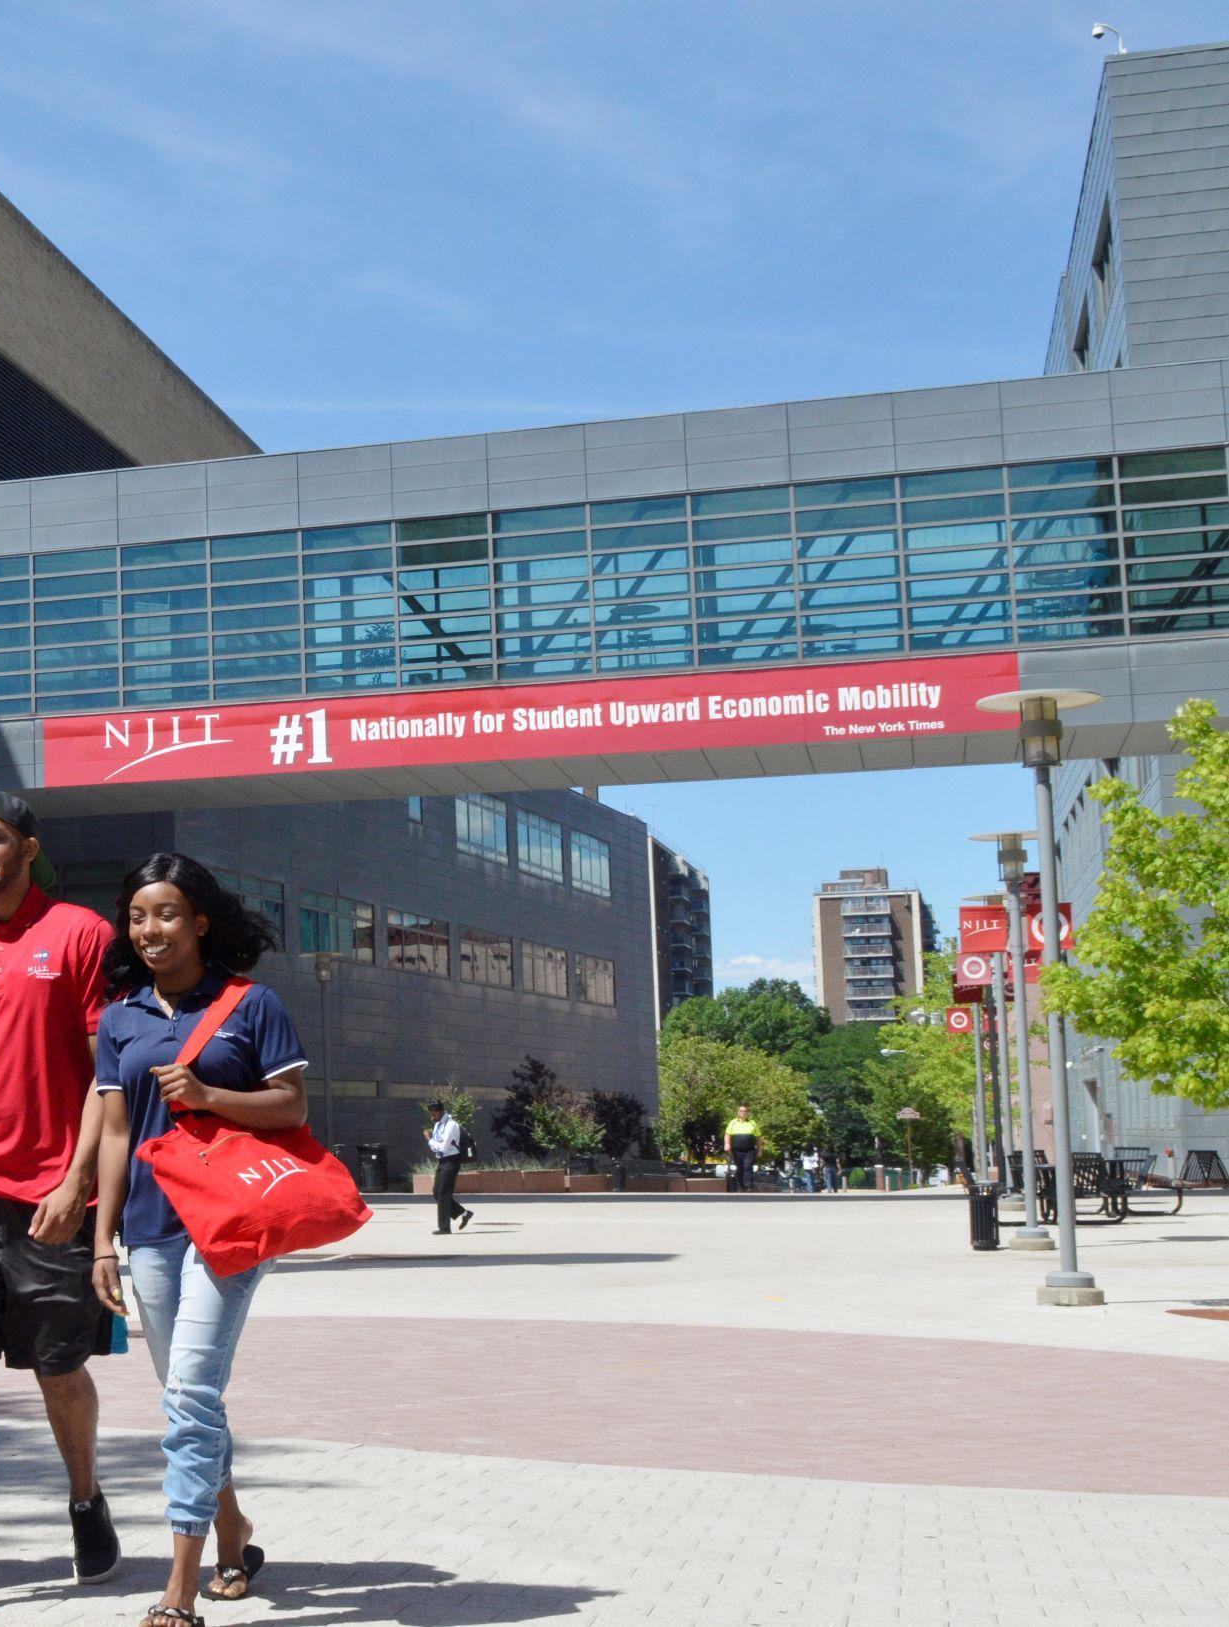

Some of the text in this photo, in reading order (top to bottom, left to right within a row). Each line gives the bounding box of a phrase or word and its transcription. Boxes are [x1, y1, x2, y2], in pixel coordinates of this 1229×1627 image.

[103, 682, 942, 765] NJIT #1 Nationally for Student Upward Economic Mobility
[823, 719, 945, 737] The New York Times
[962, 919, 1000, 930] NJIT
[237, 1158, 300, 1185] NJIT
